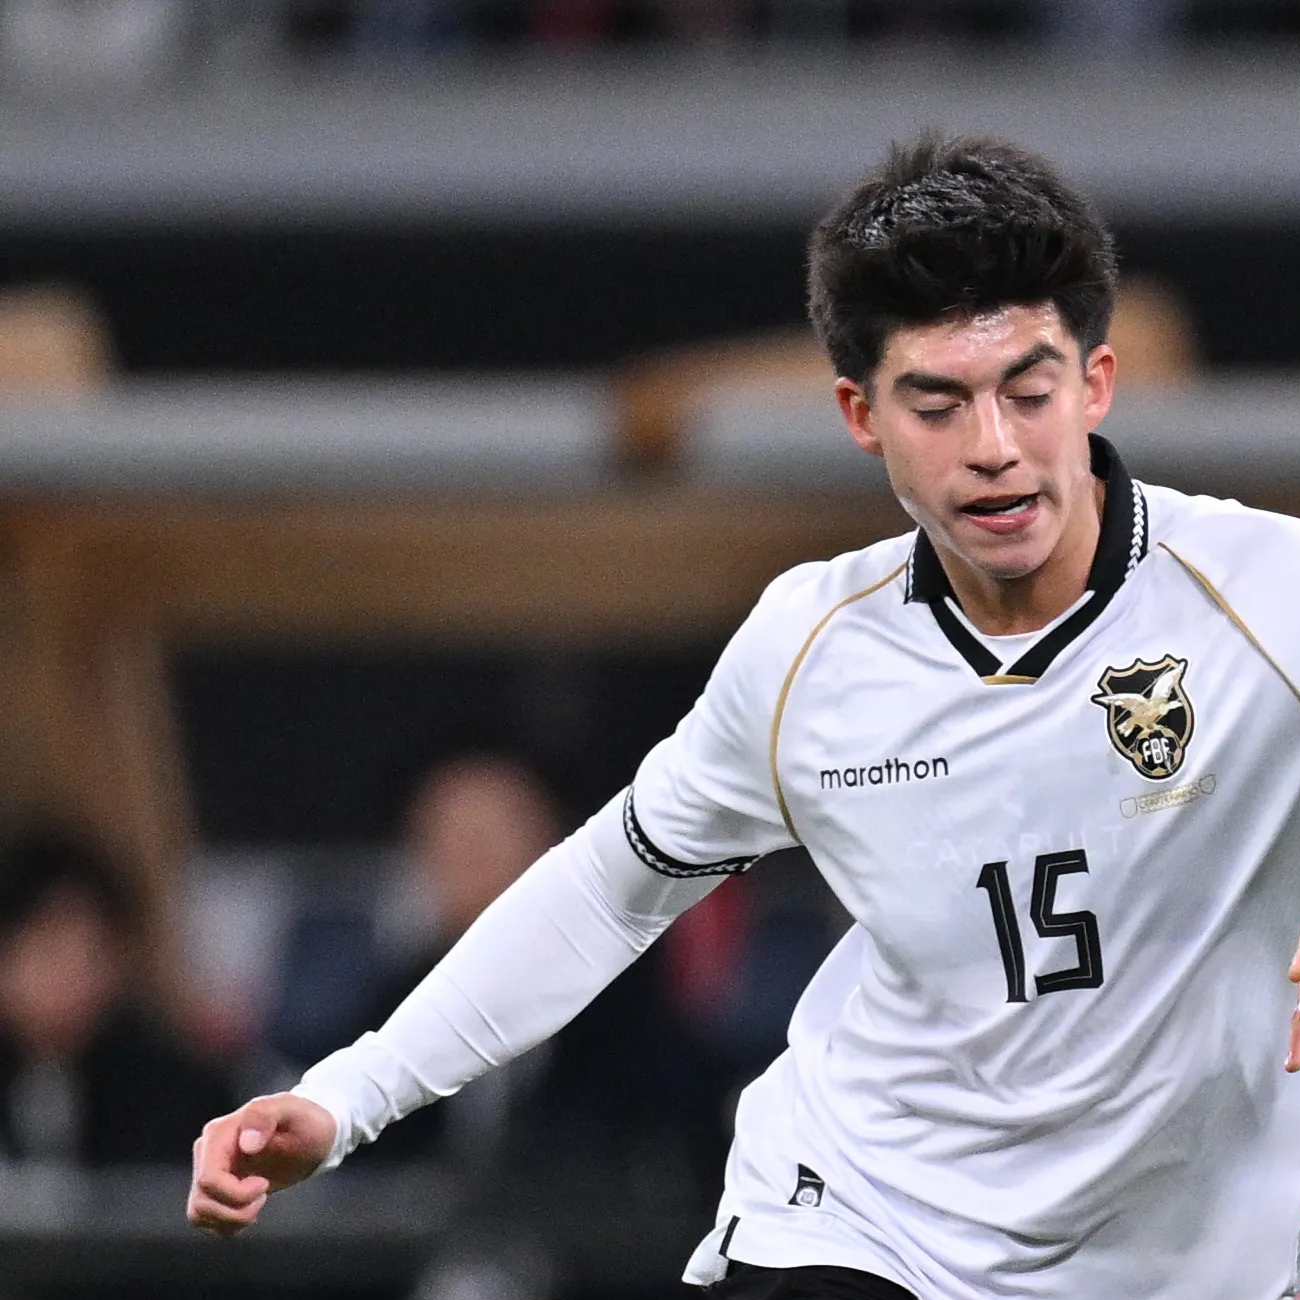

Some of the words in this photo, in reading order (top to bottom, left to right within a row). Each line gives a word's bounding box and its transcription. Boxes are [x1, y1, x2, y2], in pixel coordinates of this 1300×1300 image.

[1142, 737, 1170, 764] FBF
[820, 755, 949, 790] marathon
[976, 848, 1104, 1003] 15
